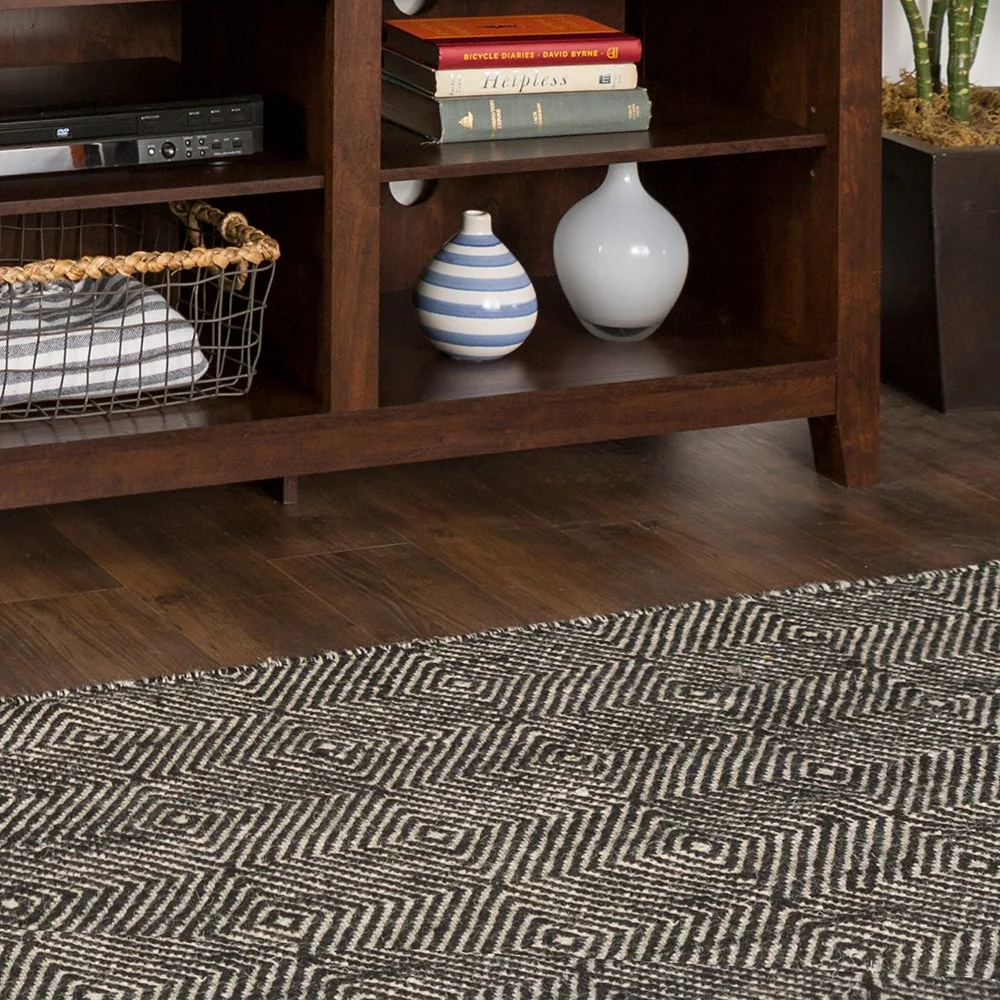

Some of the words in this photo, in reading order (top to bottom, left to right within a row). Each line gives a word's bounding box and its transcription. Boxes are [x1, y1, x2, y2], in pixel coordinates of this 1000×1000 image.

[463, 52, 499, 61] BICYCLE
[501, 51, 535, 60] DIARIES
[542, 50, 569, 59] DAVID
[570, 49, 599, 58] BYRNE
[482, 69, 568, 93] Helpless
